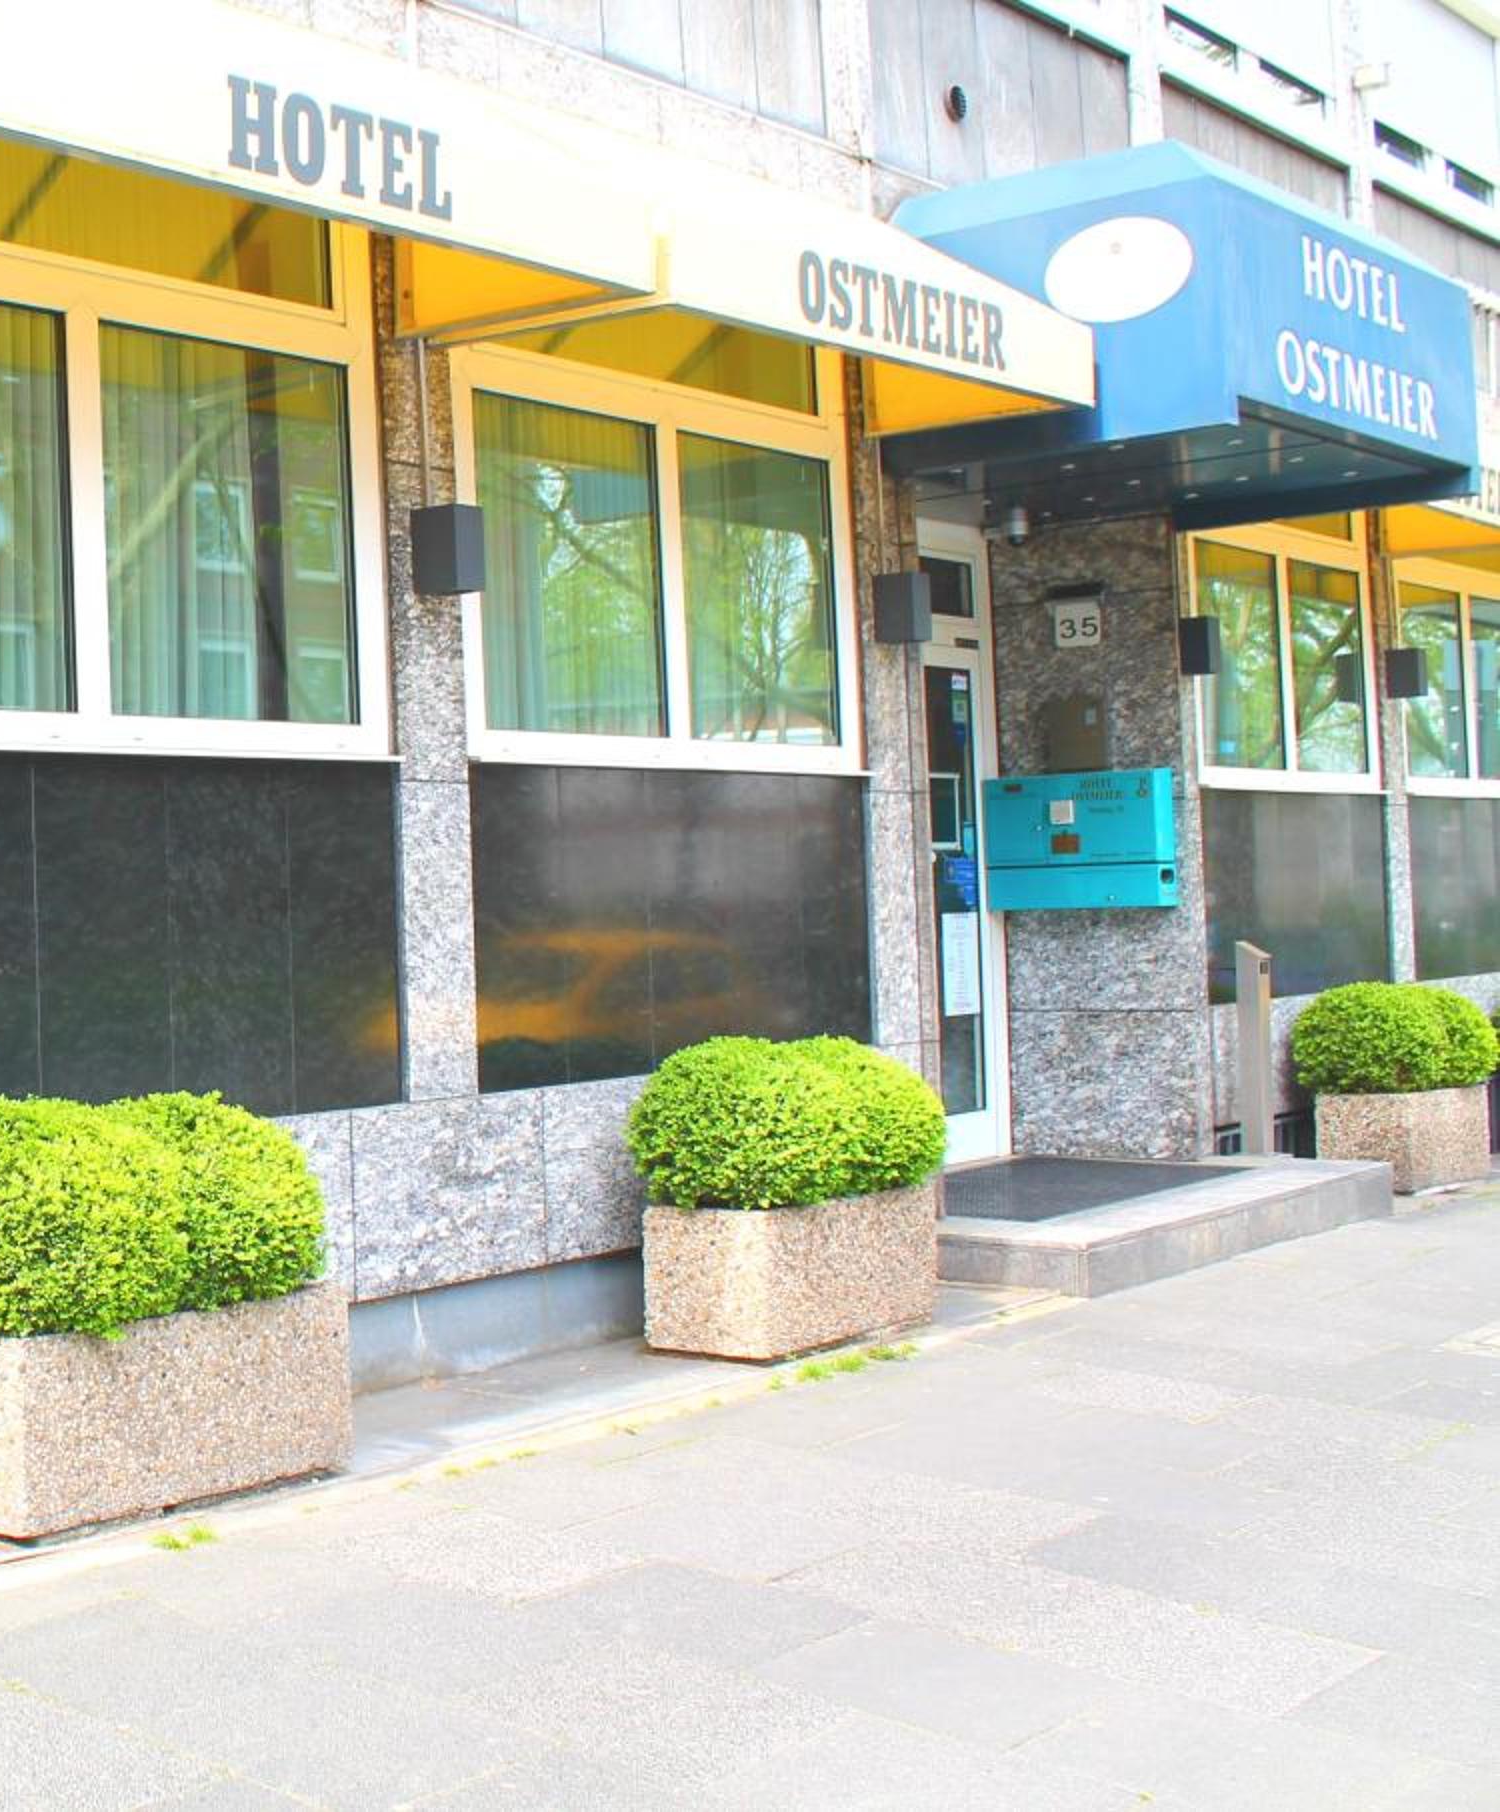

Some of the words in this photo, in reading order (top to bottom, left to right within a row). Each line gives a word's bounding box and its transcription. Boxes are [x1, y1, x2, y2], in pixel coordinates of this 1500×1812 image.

[229, 76, 452, 221] HOTEL
[800, 250, 1006, 371] OSTMEIER
[1304, 236, 1405, 333] HOTEL
[1277, 330, 1437, 440] OSTMEIER
[1060, 616, 1098, 639] 35
